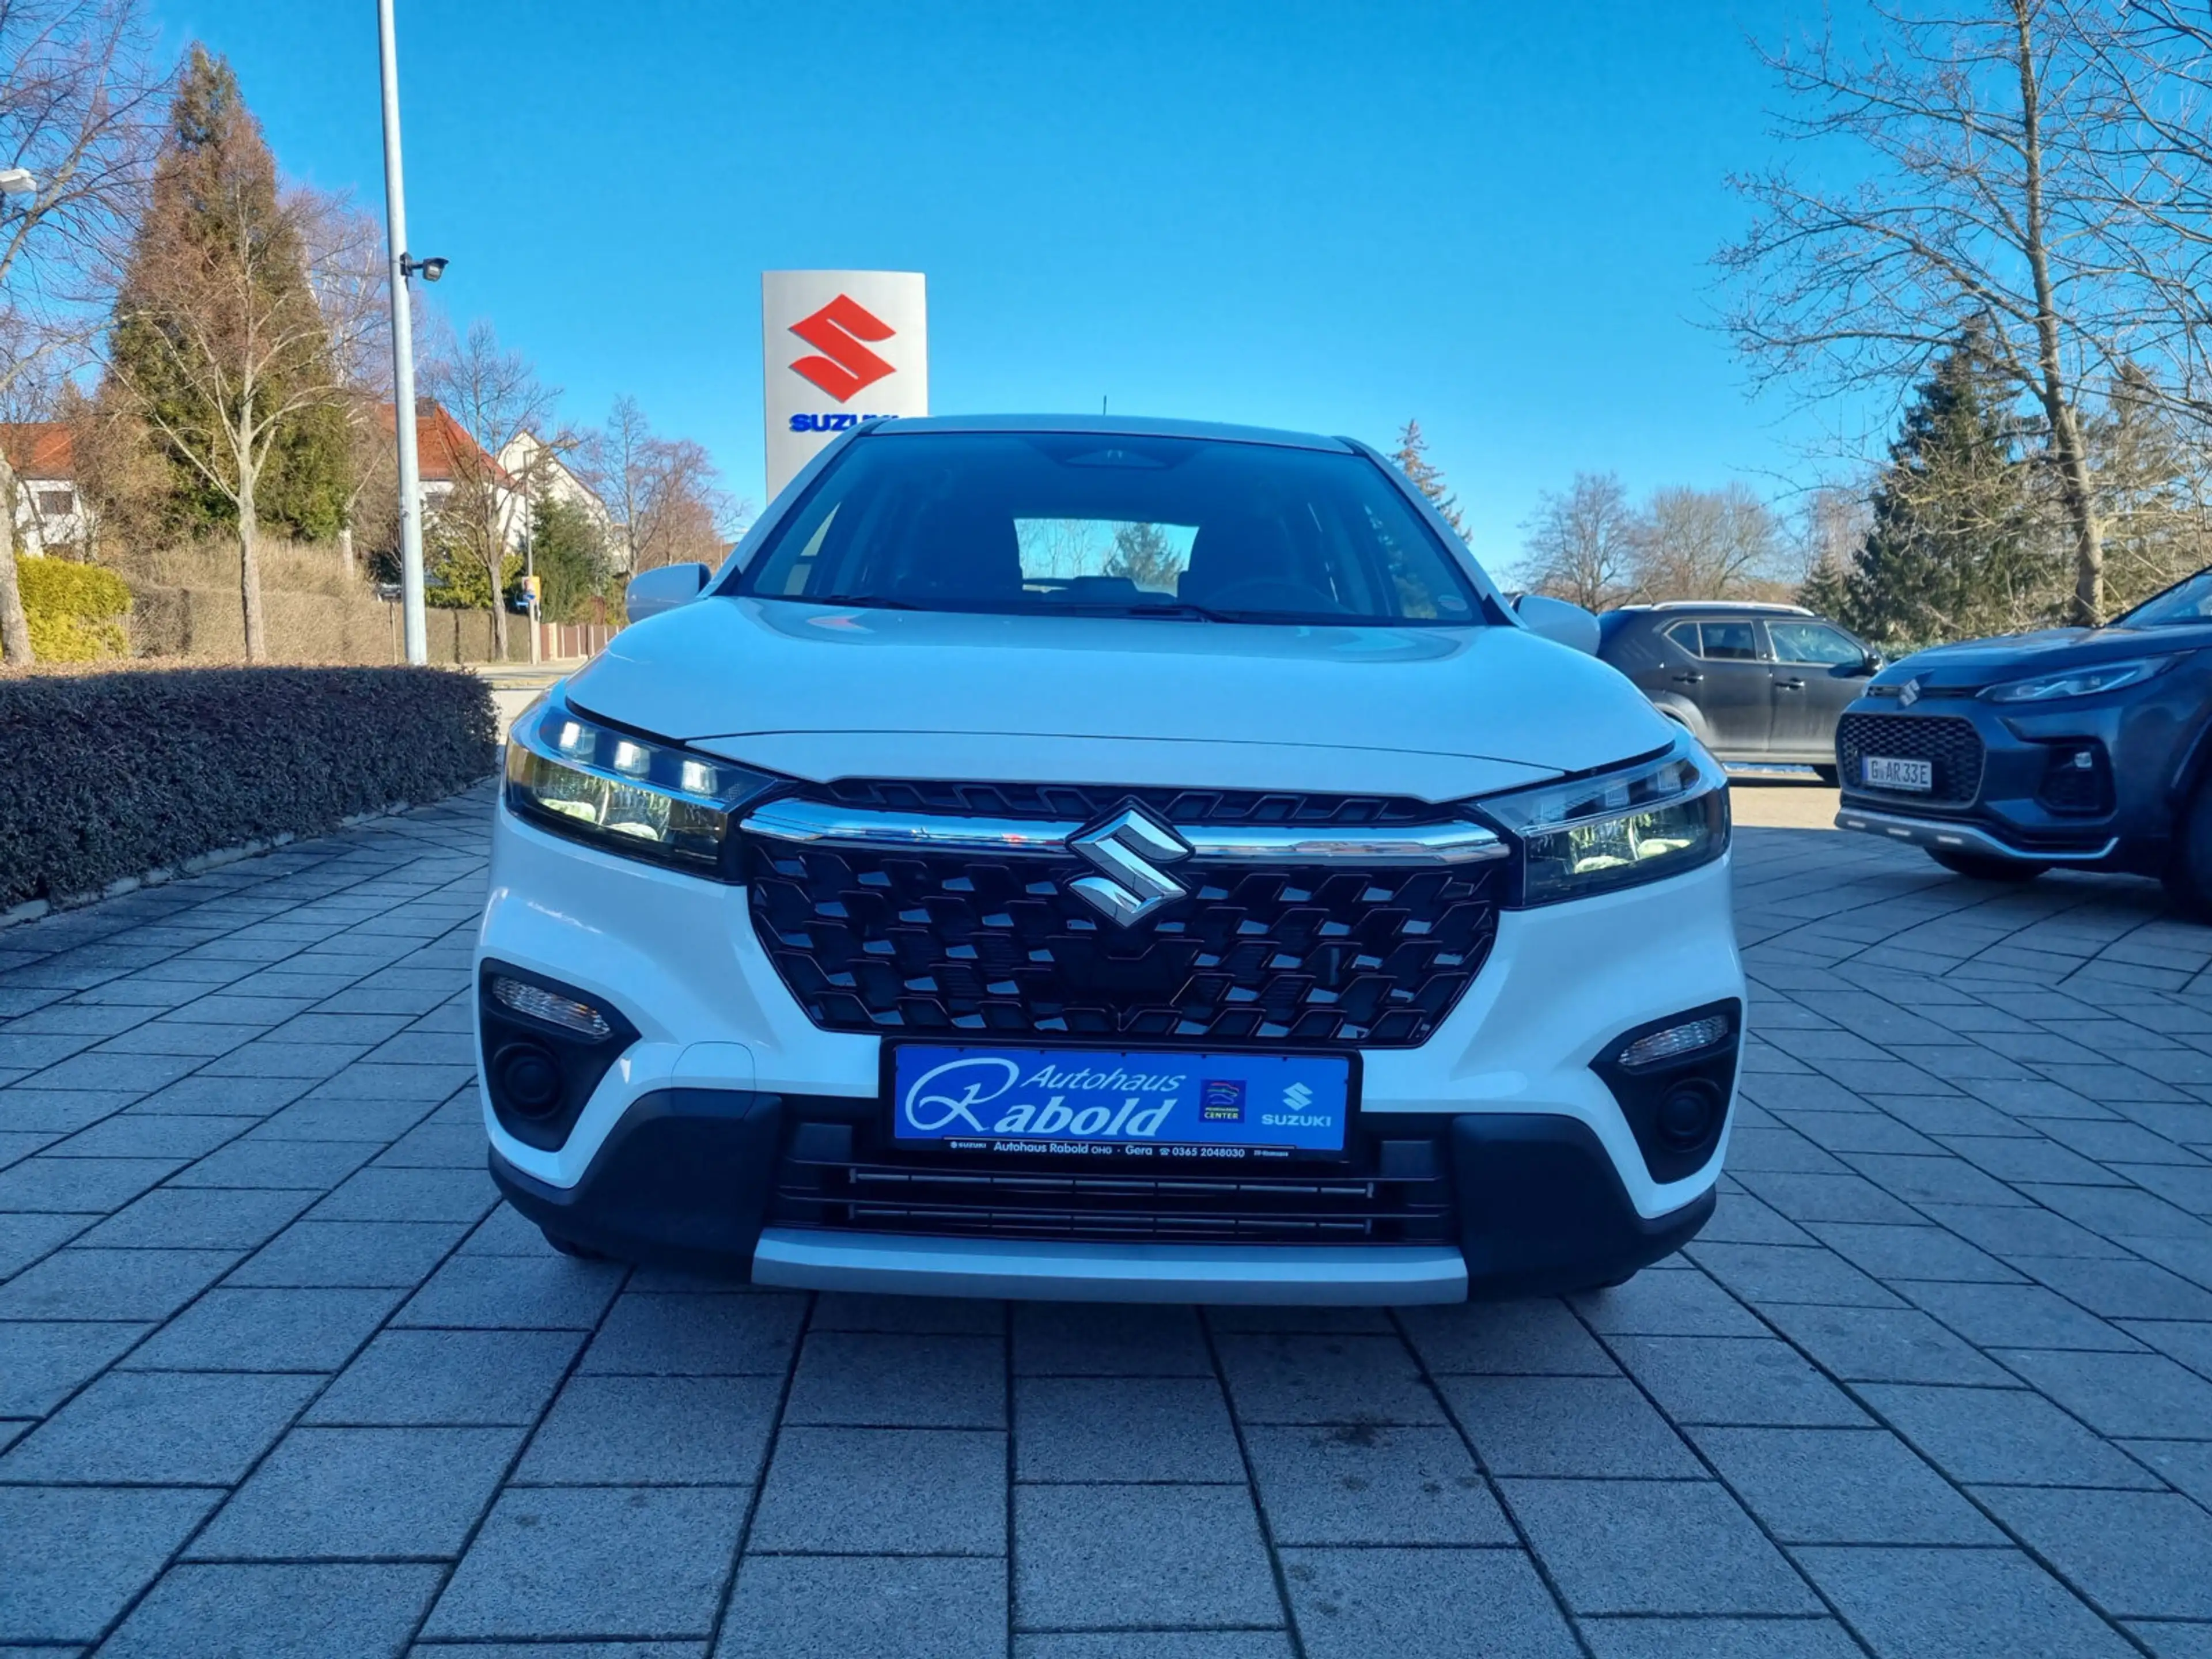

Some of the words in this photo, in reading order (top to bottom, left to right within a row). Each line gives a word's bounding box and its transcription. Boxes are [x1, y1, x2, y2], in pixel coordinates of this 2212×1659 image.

[790, 413, 899, 432] SUZ
[1871, 760, 1878, 779] G
[1019, 1064, 1187, 1092] Autohaus
[905, 1057, 1178, 1137] Rabold
[1261, 1113, 1332, 1127] SUZUKI
[994, 1142, 1047, 1152] Autohaus
[1050, 1143, 1089, 1154] Rabold
[1125, 1145, 1153, 1155] Gera
[1172, 1147, 1198, 1156] 0365
[1200, 1147, 1245, 1158] 2048030
